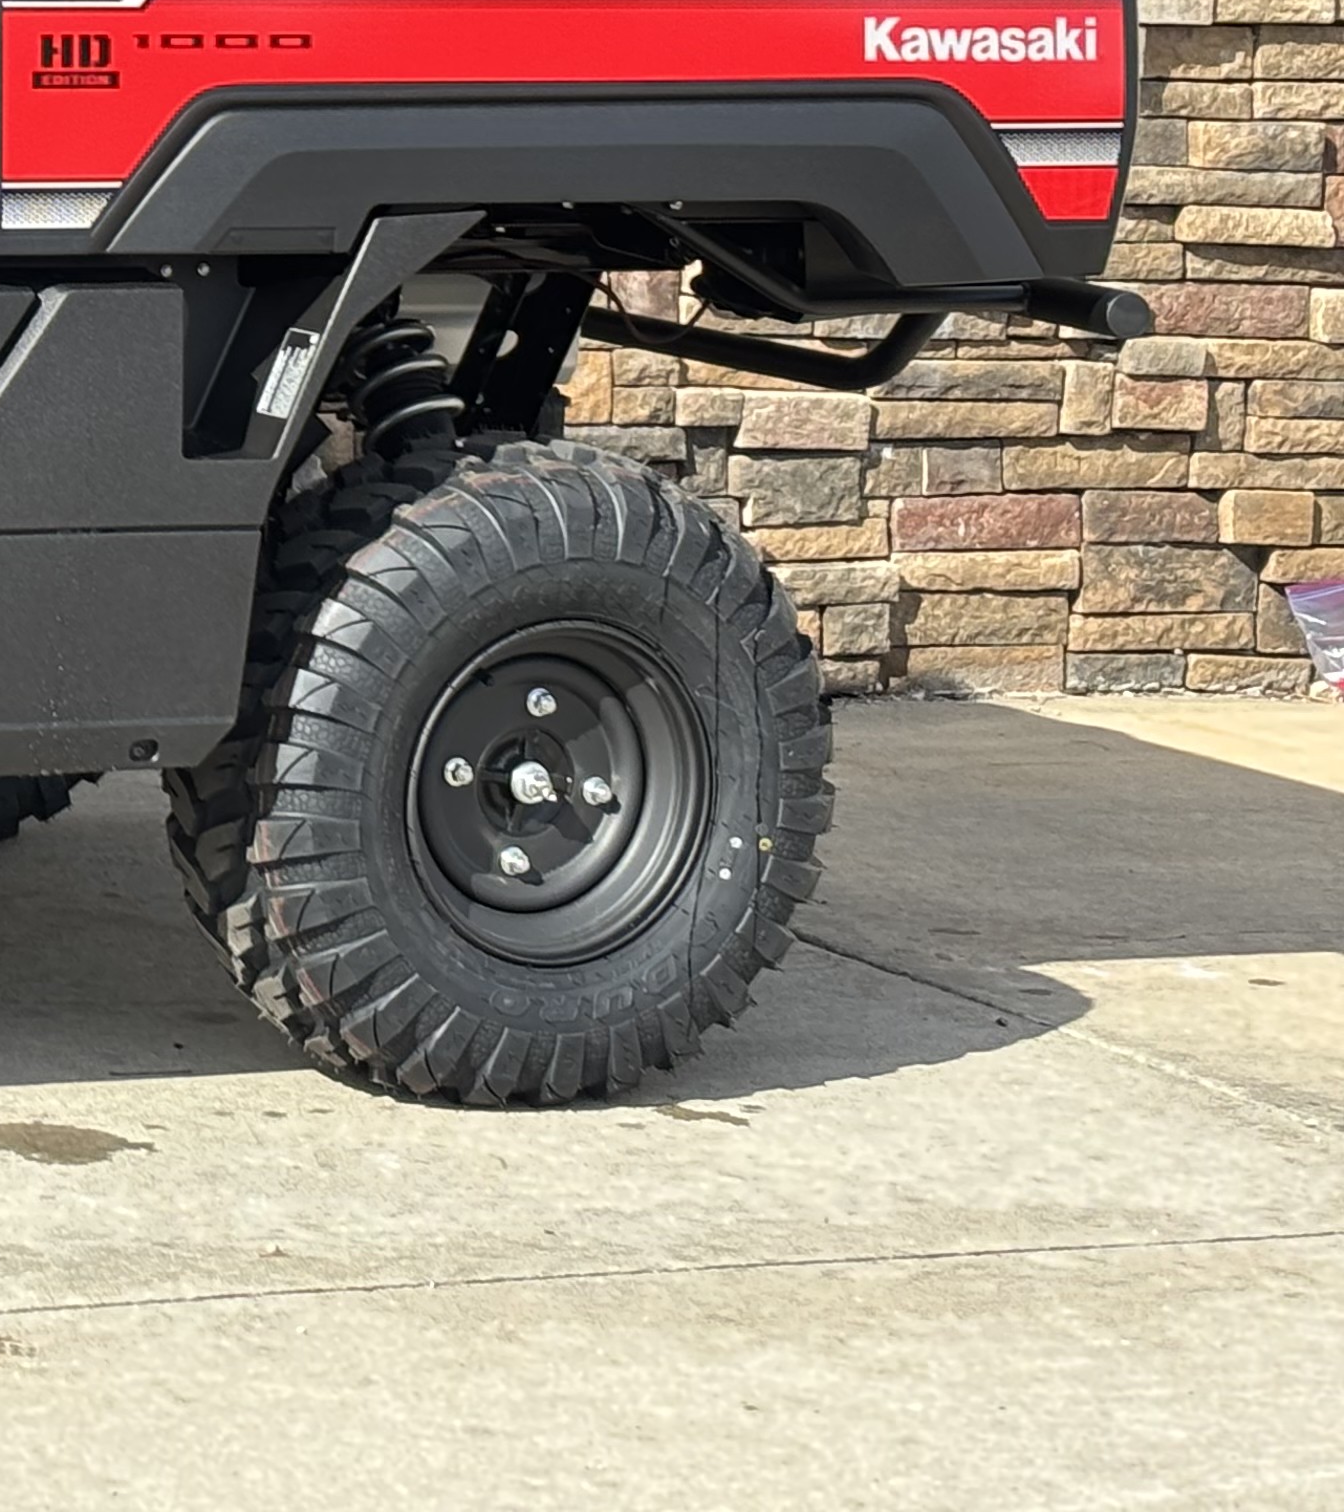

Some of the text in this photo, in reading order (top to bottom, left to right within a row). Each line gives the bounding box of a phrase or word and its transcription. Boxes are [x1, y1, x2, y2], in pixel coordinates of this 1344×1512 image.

[40, 33, 311, 68] HD 1000
[863, 16, 1097, 62] Kawasaki
[39, 73, 112, 86] EDITION
